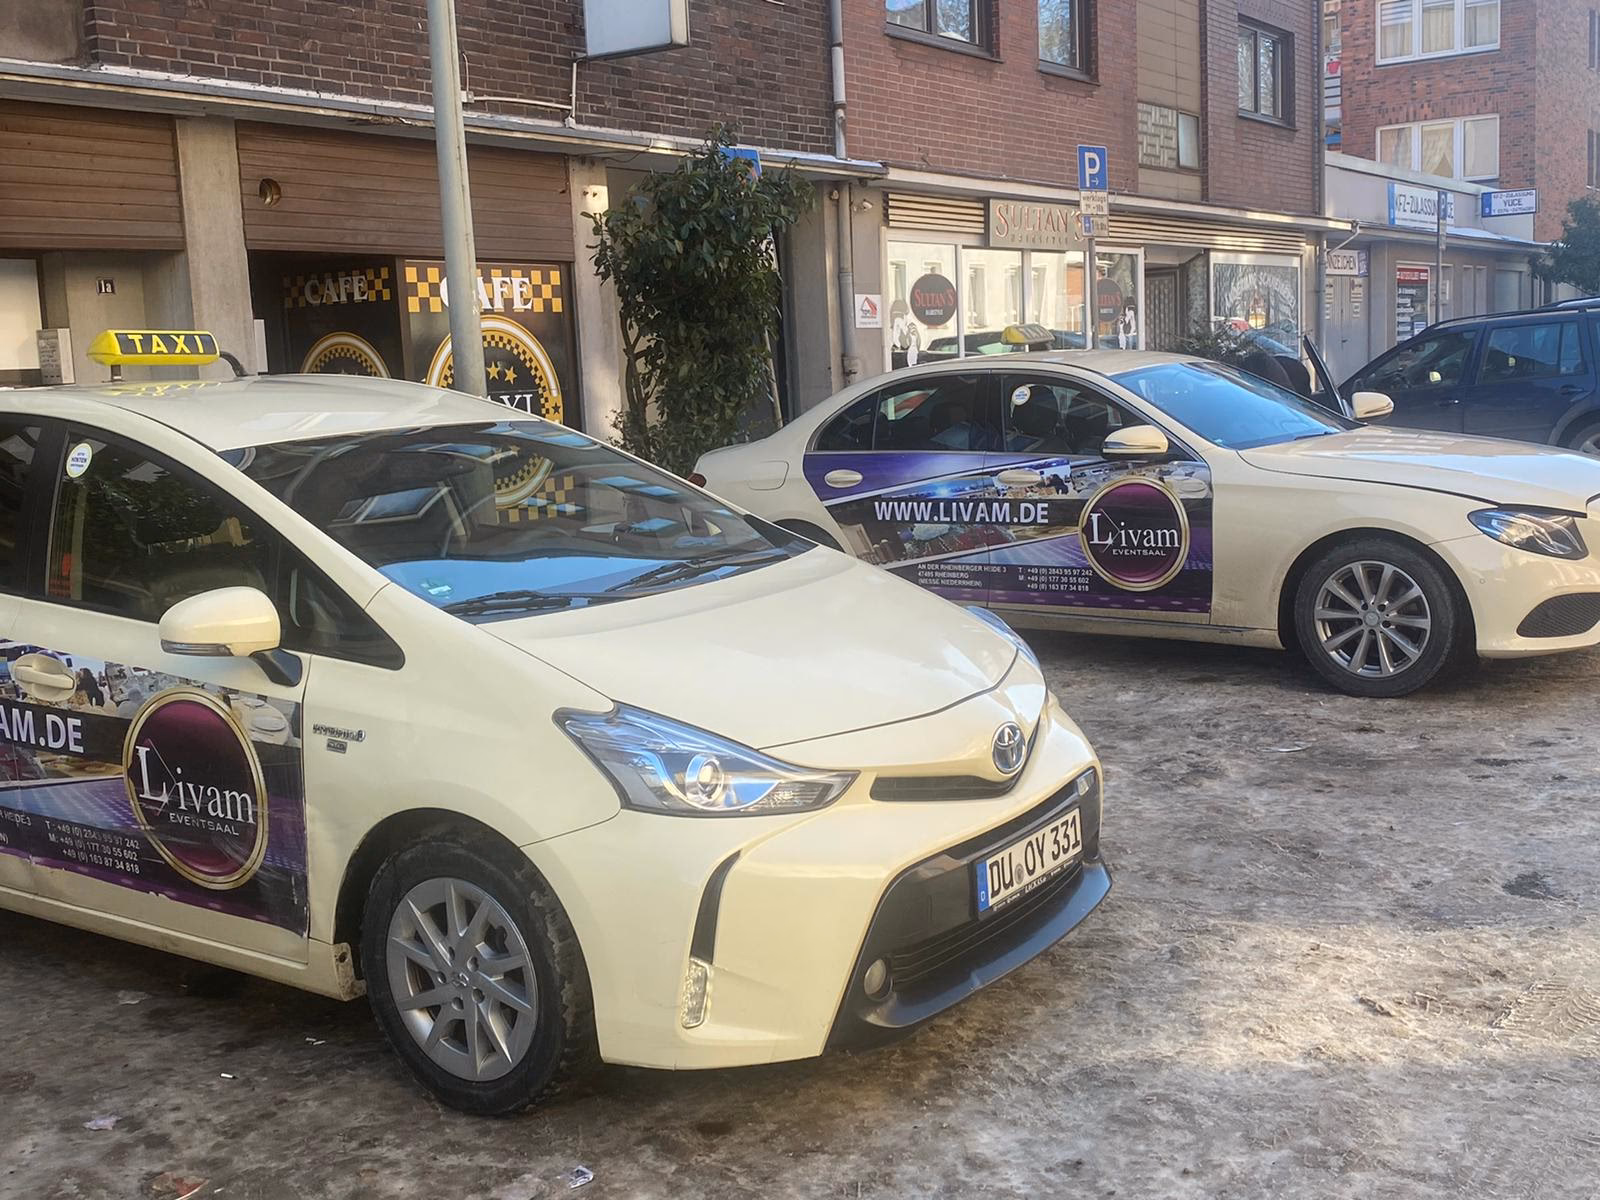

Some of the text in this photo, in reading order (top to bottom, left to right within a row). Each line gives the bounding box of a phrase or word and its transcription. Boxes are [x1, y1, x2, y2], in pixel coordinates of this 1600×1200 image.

[1084, 151, 1100, 188] P
[304, 275, 368, 304] CAFE
[440, 276, 533, 310] AFE
[127, 334, 204, 354] TAXI
[874, 501, 1049, 524] WWW.LIVAM.DE
[1089, 512, 1180, 548] Livam
[1112, 548, 1167, 556] EVENTSAAL
[135, 745, 257, 825] Livam
[169, 812, 240, 836] EVENTSAAL
[112, 847, 123, 857] 55
[124, 849, 138, 861] 602
[125, 838, 140, 849] 242
[989, 852, 1014, 899] DU
[1024, 832, 1046, 877] OY
[1050, 814, 1081, 861] 331
[62, 848, 76, 859] +49
[114, 859, 124, 870] 34
[125, 862, 140, 874] 818
